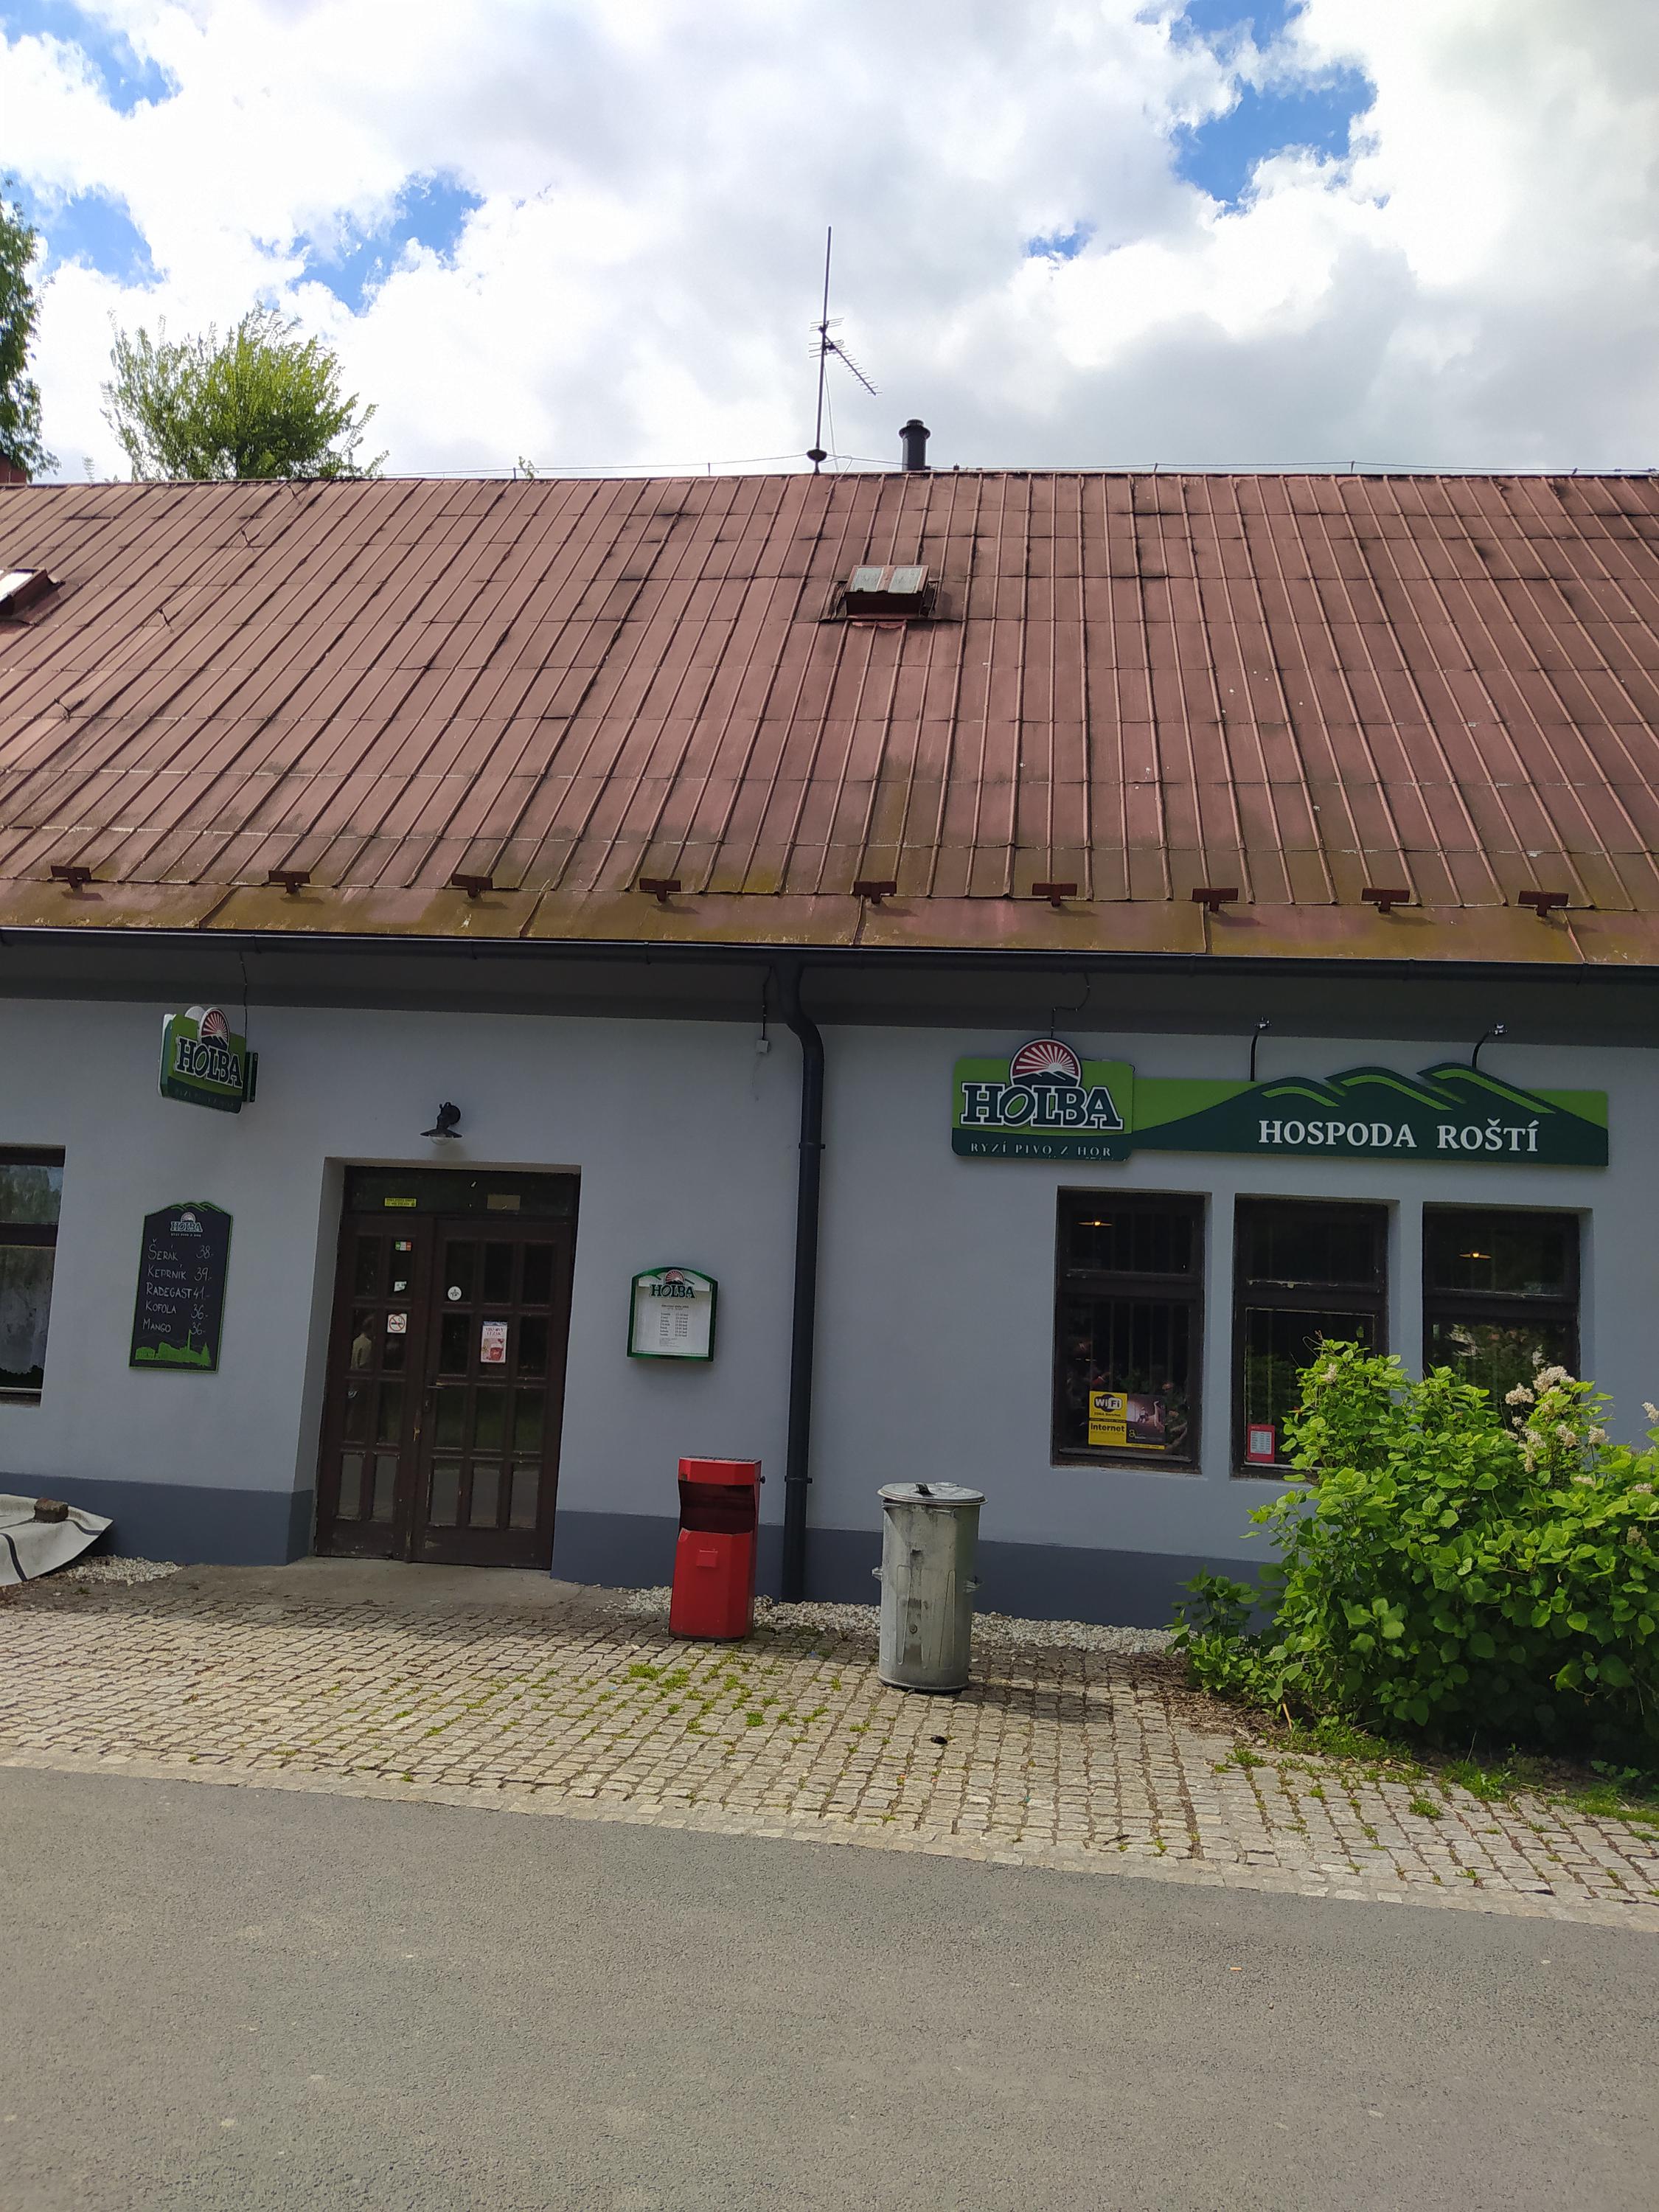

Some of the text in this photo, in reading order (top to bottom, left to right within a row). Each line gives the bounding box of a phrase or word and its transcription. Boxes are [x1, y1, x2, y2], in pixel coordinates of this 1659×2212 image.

[175, 1034, 243, 1089] HOLBA
[960, 1082, 1124, 1130] HOLBA
[1258, 1117, 1540, 1152] HOSPODA ROŠTÍ
[970, 1141, 1007, 1153] RYZÍ
[1015, 1144, 1052, 1155] PIVO
[1077, 1146, 1111, 1157] HOR
[170, 1221, 204, 1233] HOLBA
[146, 1281, 192, 1298] RADEGAST
[650, 1284, 696, 1298] HOLBA
[1091, 1423, 1124, 1432] Internet
